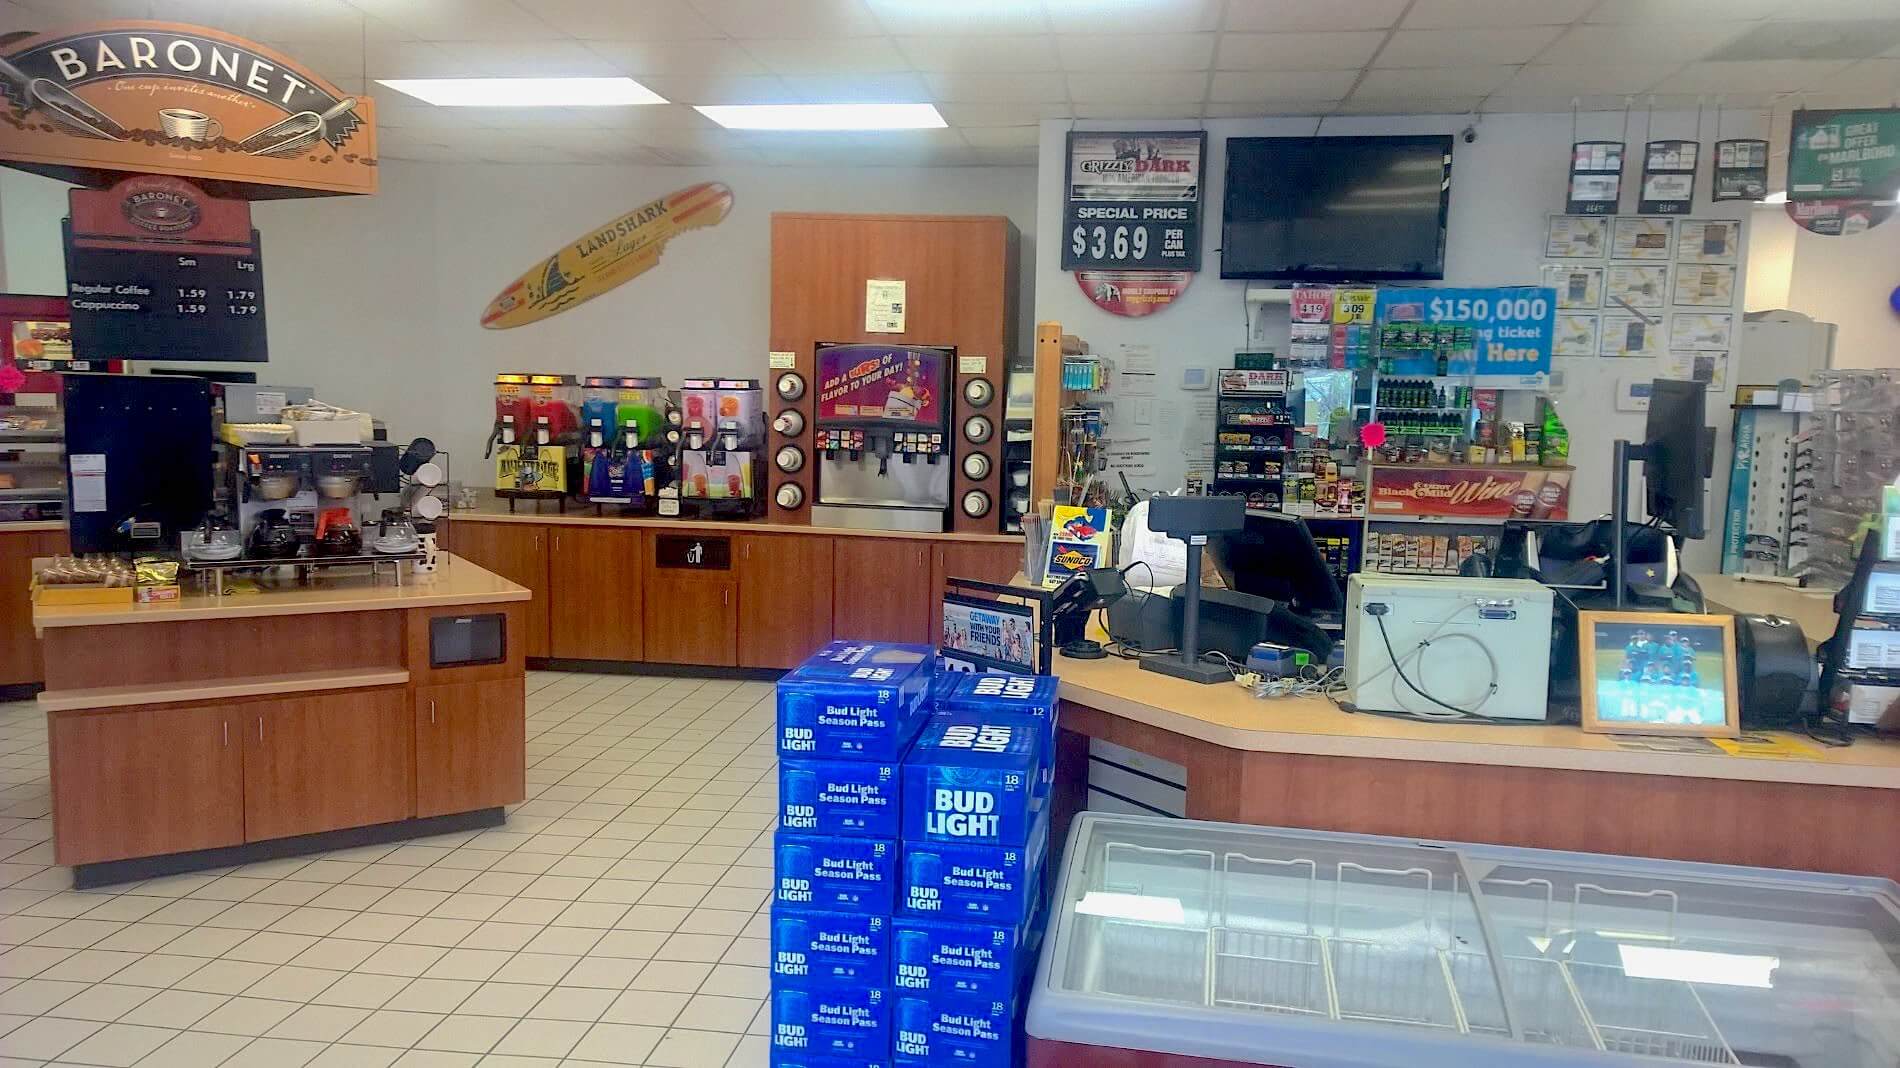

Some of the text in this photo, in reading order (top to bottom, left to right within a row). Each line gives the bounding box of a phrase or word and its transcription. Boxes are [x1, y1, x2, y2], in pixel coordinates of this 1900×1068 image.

[51, 37, 306, 104] BARONET
[137, 84, 159, 97] cup
[163, 83, 205, 96] invites
[1081, 158, 1192, 175] GRIZZLY DARK
[132, 191, 189, 205] BARONET
[1077, 207, 1188, 219] SPECIAL PRICE
[575, 199, 668, 259] LANDSHARK
[1165, 229, 1184, 240] PER
[1164, 239, 1184, 250] CAN
[178, 256, 255, 272] Sm Lrg
[71, 283, 255, 301] Regular Coffee 1.59 1.79
[71, 299, 257, 315] Cappuccino 1.59 1.79
[1429, 297, 1548, 323] $150,000
[1498, 325, 1542, 339] ticket
[882, 353, 893, 365] OF
[1487, 343, 1539, 363] Here
[820, 385, 849, 403] FLAVOR
[850, 380, 860, 392] TO
[862, 371, 883, 387] YOUR
[884, 362, 904, 377] DAY!
[824, 373, 848, 390] ADD A
[1378, 487, 1411, 497] Black
[1450, 475, 1521, 505] Wine
[1055, 555, 1093, 566] SUNOCO
[969, 611, 1000, 624] GETAWAY
[969, 622, 1001, 635] WITH YOUR
[970, 630, 1001, 647] FRIENDS
[877, 690, 890, 699] 18
[973, 676, 1036, 699] BUD LIGHT
[826, 705, 878, 719] Bud Light
[1032, 707, 1045, 717] 12
[818, 715, 886, 728] Season Pass
[785, 727, 813, 740] BUD
[939, 724, 1012, 753] BUD LIGHT
[781, 739, 816, 751] LIGHT
[879, 767, 891, 776] 18
[1005, 775, 1019, 785] 18
[827, 783, 880, 797] Bud Light
[818, 792, 887, 806] Season Pass
[935, 789, 994, 814] BUD
[786, 804, 815, 817] BUD
[783, 816, 818, 828] LIGHT
[927, 812, 999, 837] LIGHT
[873, 843, 886, 852] 18
[1004, 852, 1017, 861] 18
[822, 858, 874, 872] Bud Light
[814, 867, 882, 881] Season Pass
[952, 866, 1004, 881] Bud Light
[781, 878, 810, 890] BUD
[943, 875, 1012, 891] Season Pass
[778, 889, 813, 902] LIGHT
[910, 886, 939, 899] BUD
[907, 897, 942, 911] LIGHT
[870, 917, 882, 926] 18
[819, 932, 870, 946] Bud Light
[992, 931, 1005, 940] 18
[810, 941, 878, 956] Season Pass
[940, 945, 993, 959] Bud Light
[777, 951, 806, 964] BUD
[931, 954, 1001, 970] Season Pass
[774, 963, 809, 976] LIGHT
[898, 964, 928, 978] BUD
[895, 976, 930, 989] LIGHT
[870, 991, 881, 1000] 18
[819, 1004, 870, 1019] Bud Light
[991, 1001, 1003, 1011] 18
[811, 1013, 878, 1028] Season Pass
[940, 1013, 991, 1029] Bud Light
[777, 1023, 806, 1036] BUD
[932, 1022, 1000, 1041] Season Pass
[774, 1035, 809, 1048] LIGHT
[899, 1030, 927, 1044] BUD
[895, 1042, 930, 1056] LIGHT
